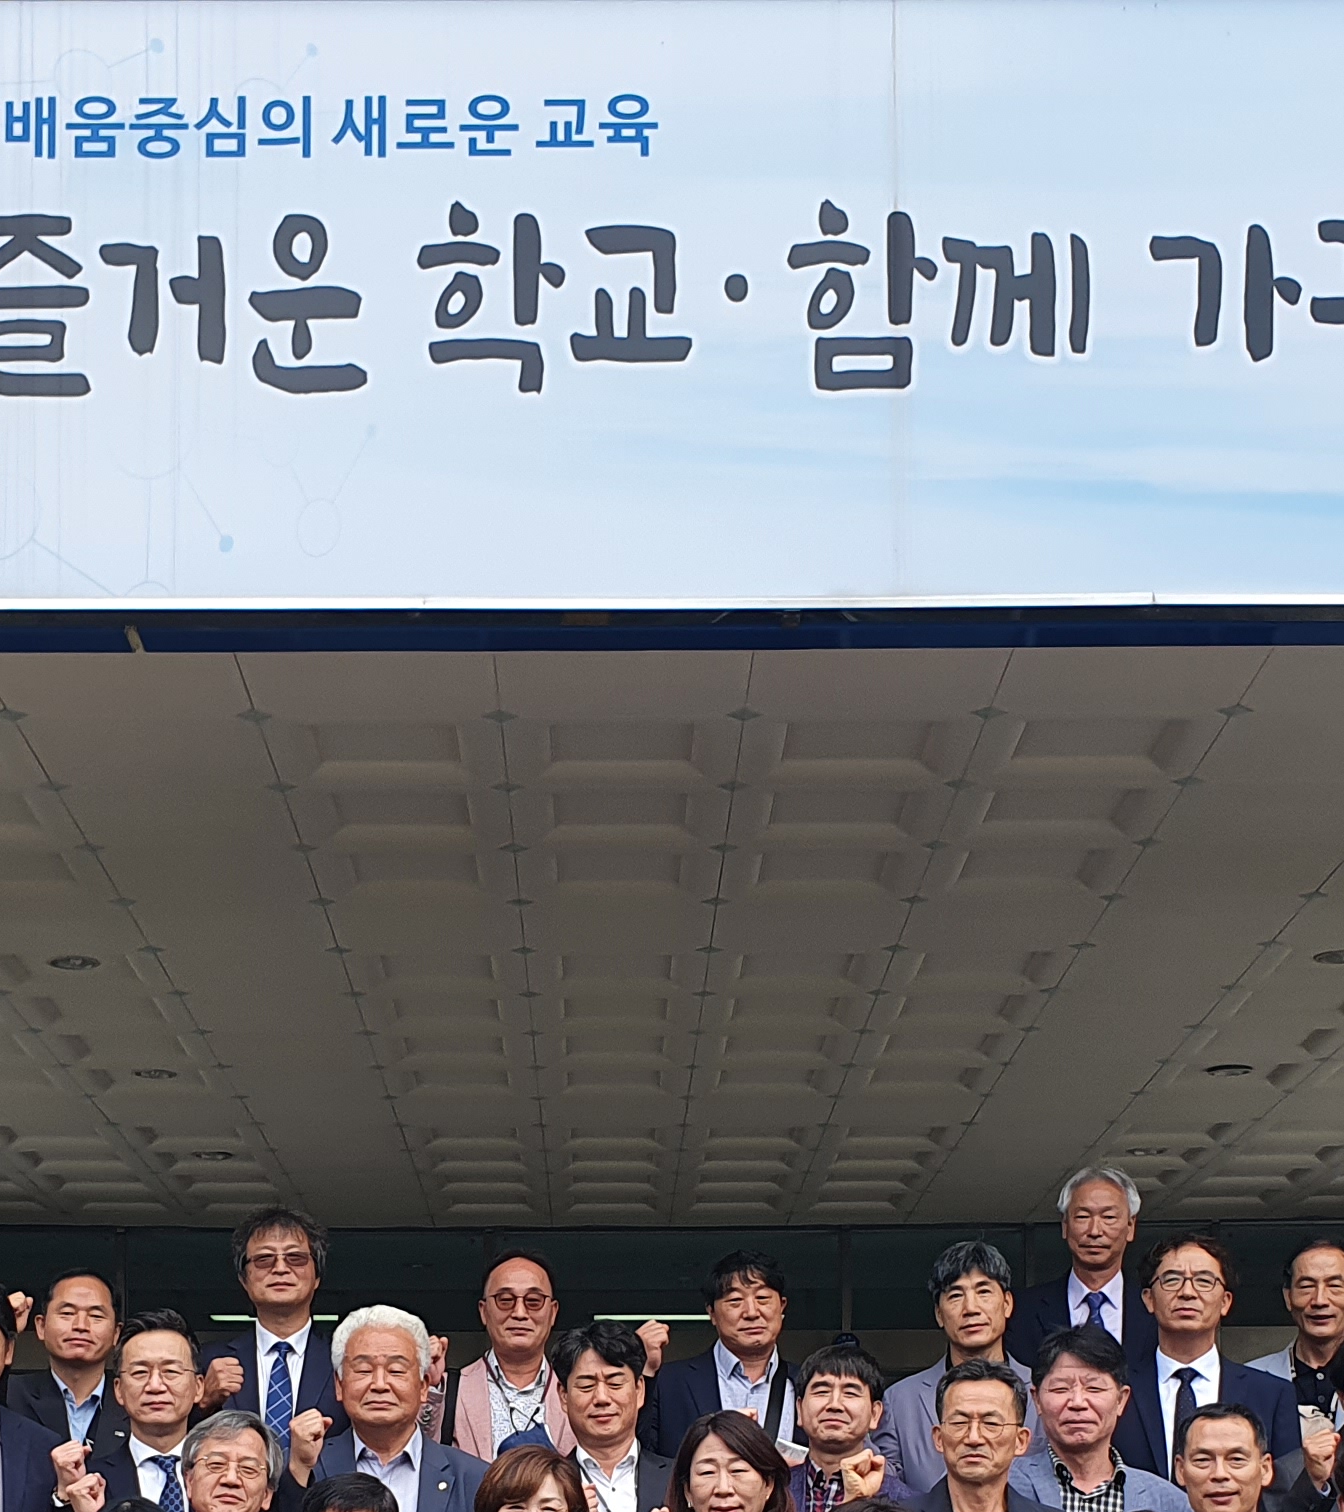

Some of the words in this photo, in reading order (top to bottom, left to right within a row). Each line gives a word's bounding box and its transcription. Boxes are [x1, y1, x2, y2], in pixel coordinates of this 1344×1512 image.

[4, 95, 312, 160] 배움중심의
[331, 94, 520, 158] 새로운
[535, 93, 659, 157] 교육
